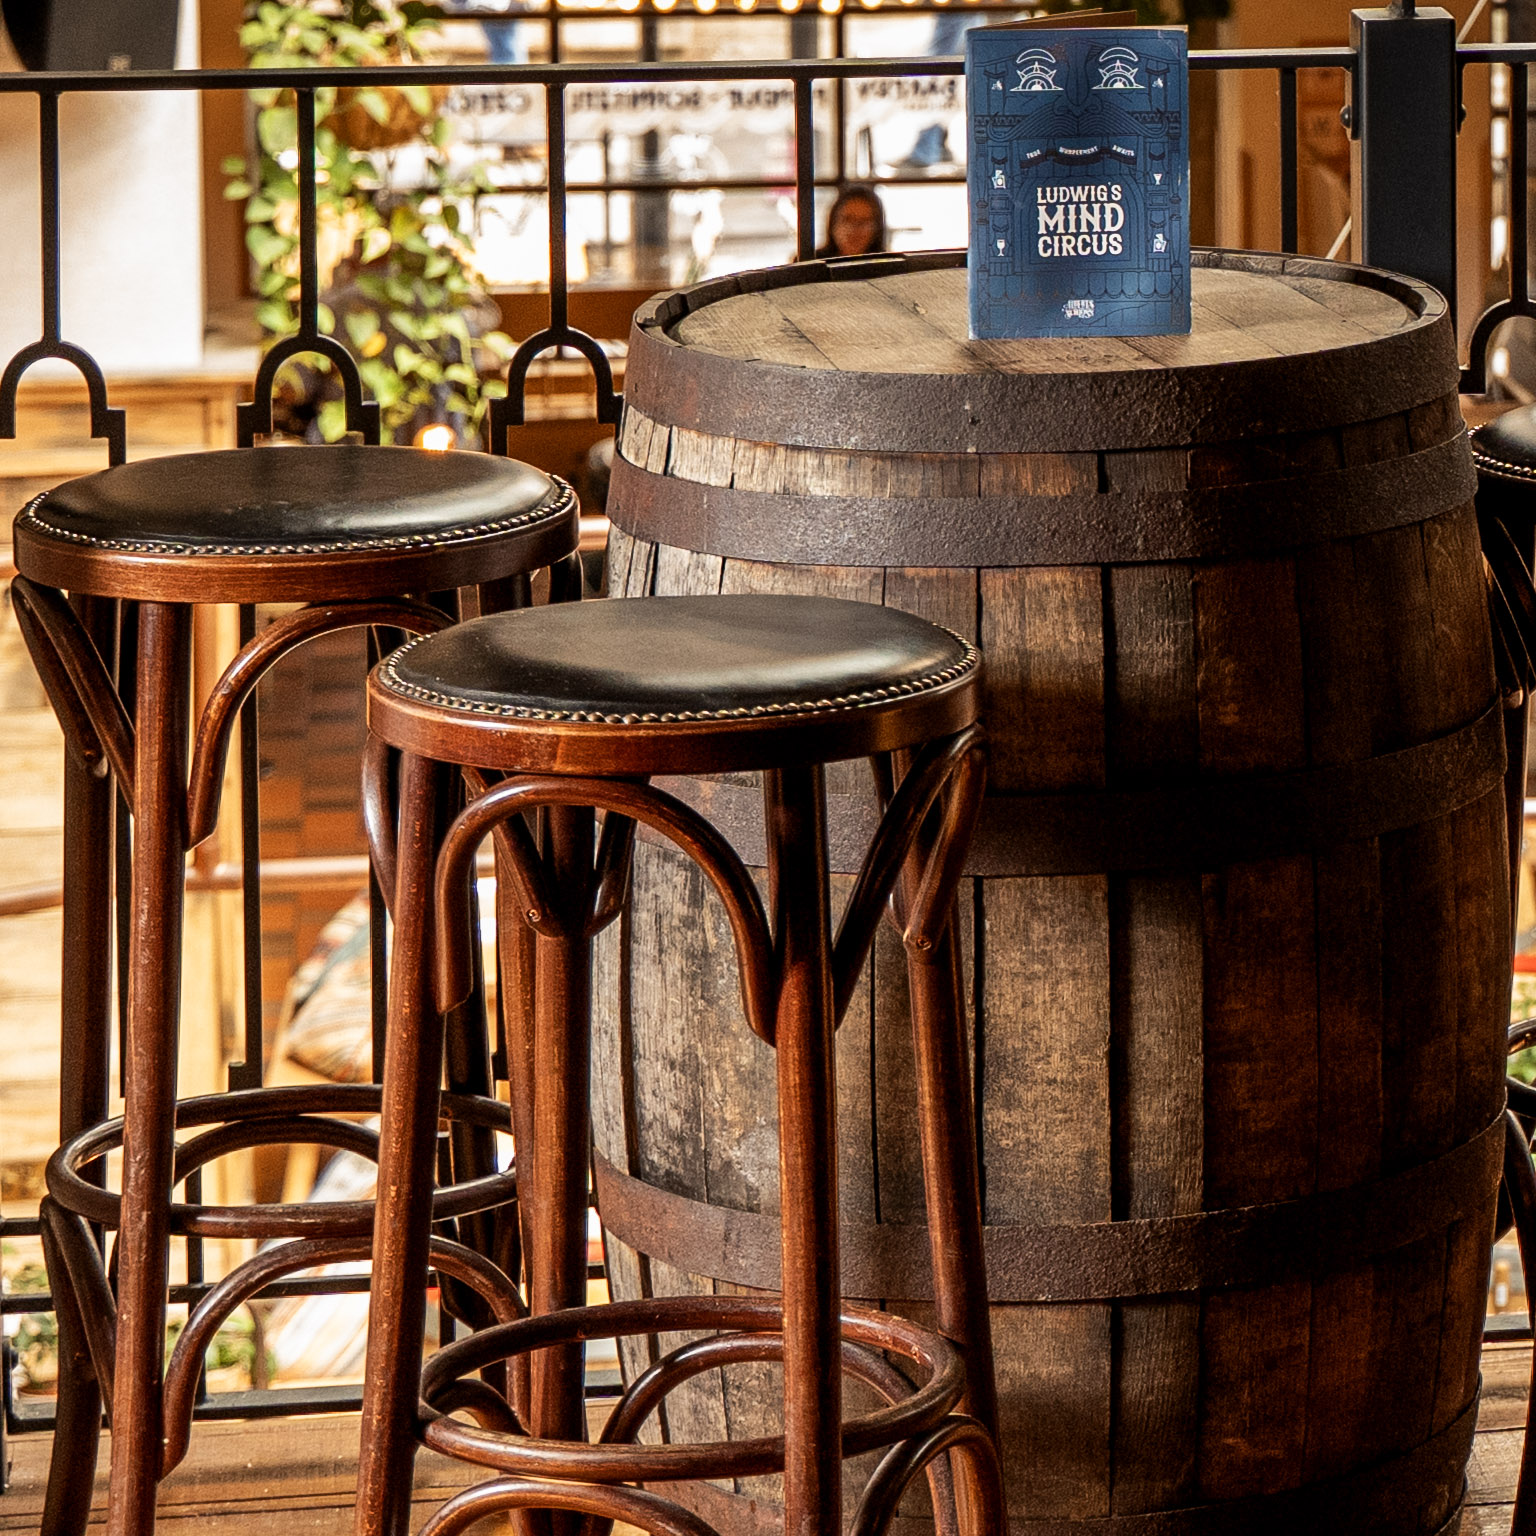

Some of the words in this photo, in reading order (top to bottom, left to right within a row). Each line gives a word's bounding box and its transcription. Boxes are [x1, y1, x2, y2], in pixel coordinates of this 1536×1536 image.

[1037, 182, 1122, 204] LUDWIG'S
[1037, 203, 1125, 235] MIND
[1038, 233, 1123, 258] CIRCUS
